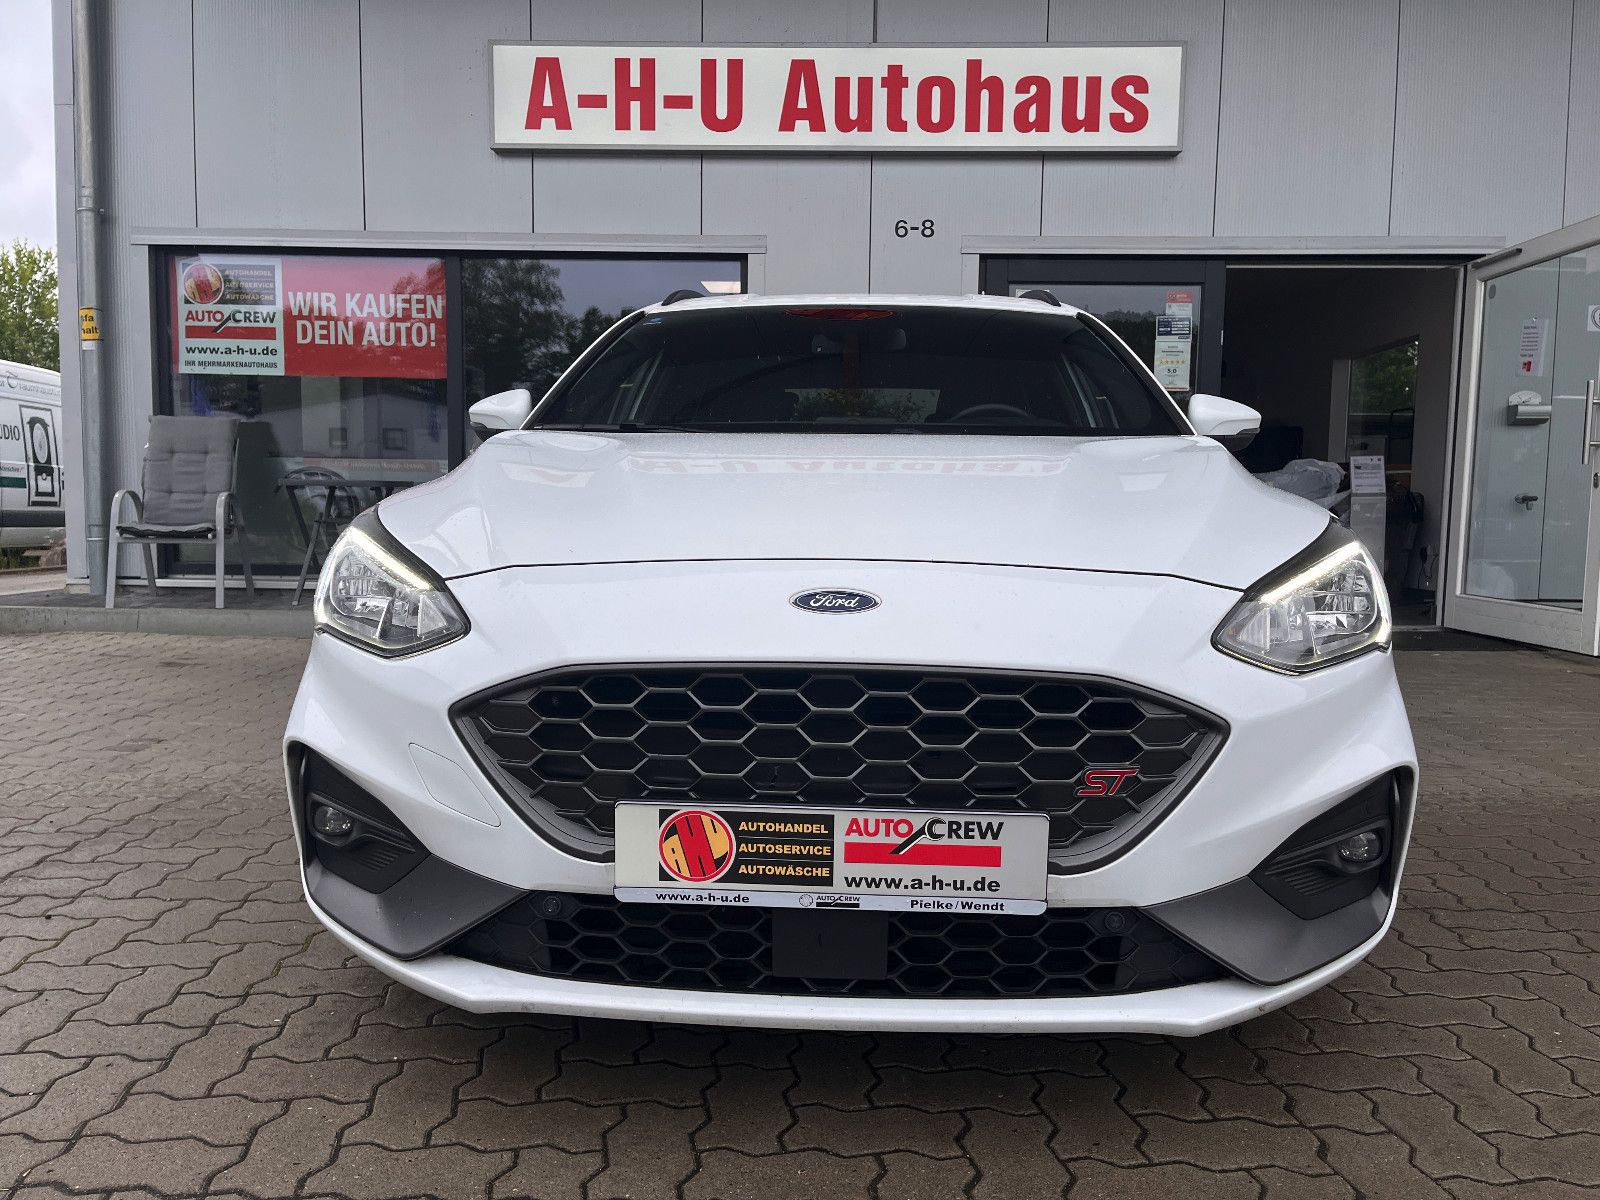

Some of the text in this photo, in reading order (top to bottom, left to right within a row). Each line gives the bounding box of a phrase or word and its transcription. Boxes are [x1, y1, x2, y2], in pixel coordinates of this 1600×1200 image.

[524, 57, 1150, 134] A-H-U Autohaus
[894, 219, 935, 239] 6-8
[287, 291, 443, 319] WIR KAUFEN
[185, 309, 276, 324] AUTO CREW
[296, 320, 436, 347] DEIN AUTO!
[185, 345, 278, 356] www.a-h-u.de
[197, 360, 278, 369] MEHRMARKENAUTOHAUS
[809, 591, 859, 609] Ford
[1077, 769, 1139, 796] ST
[738, 821, 829, 834] AUTOHANDEL
[844, 817, 1005, 841] AUTO CREW
[738, 843, 832, 856] AUTOSERVICE
[738, 863, 831, 878] AUTOWÄSCHE
[844, 874, 1001, 893] www.a-h-u.de
[655, 893, 750, 904] www.a-h-u.de
